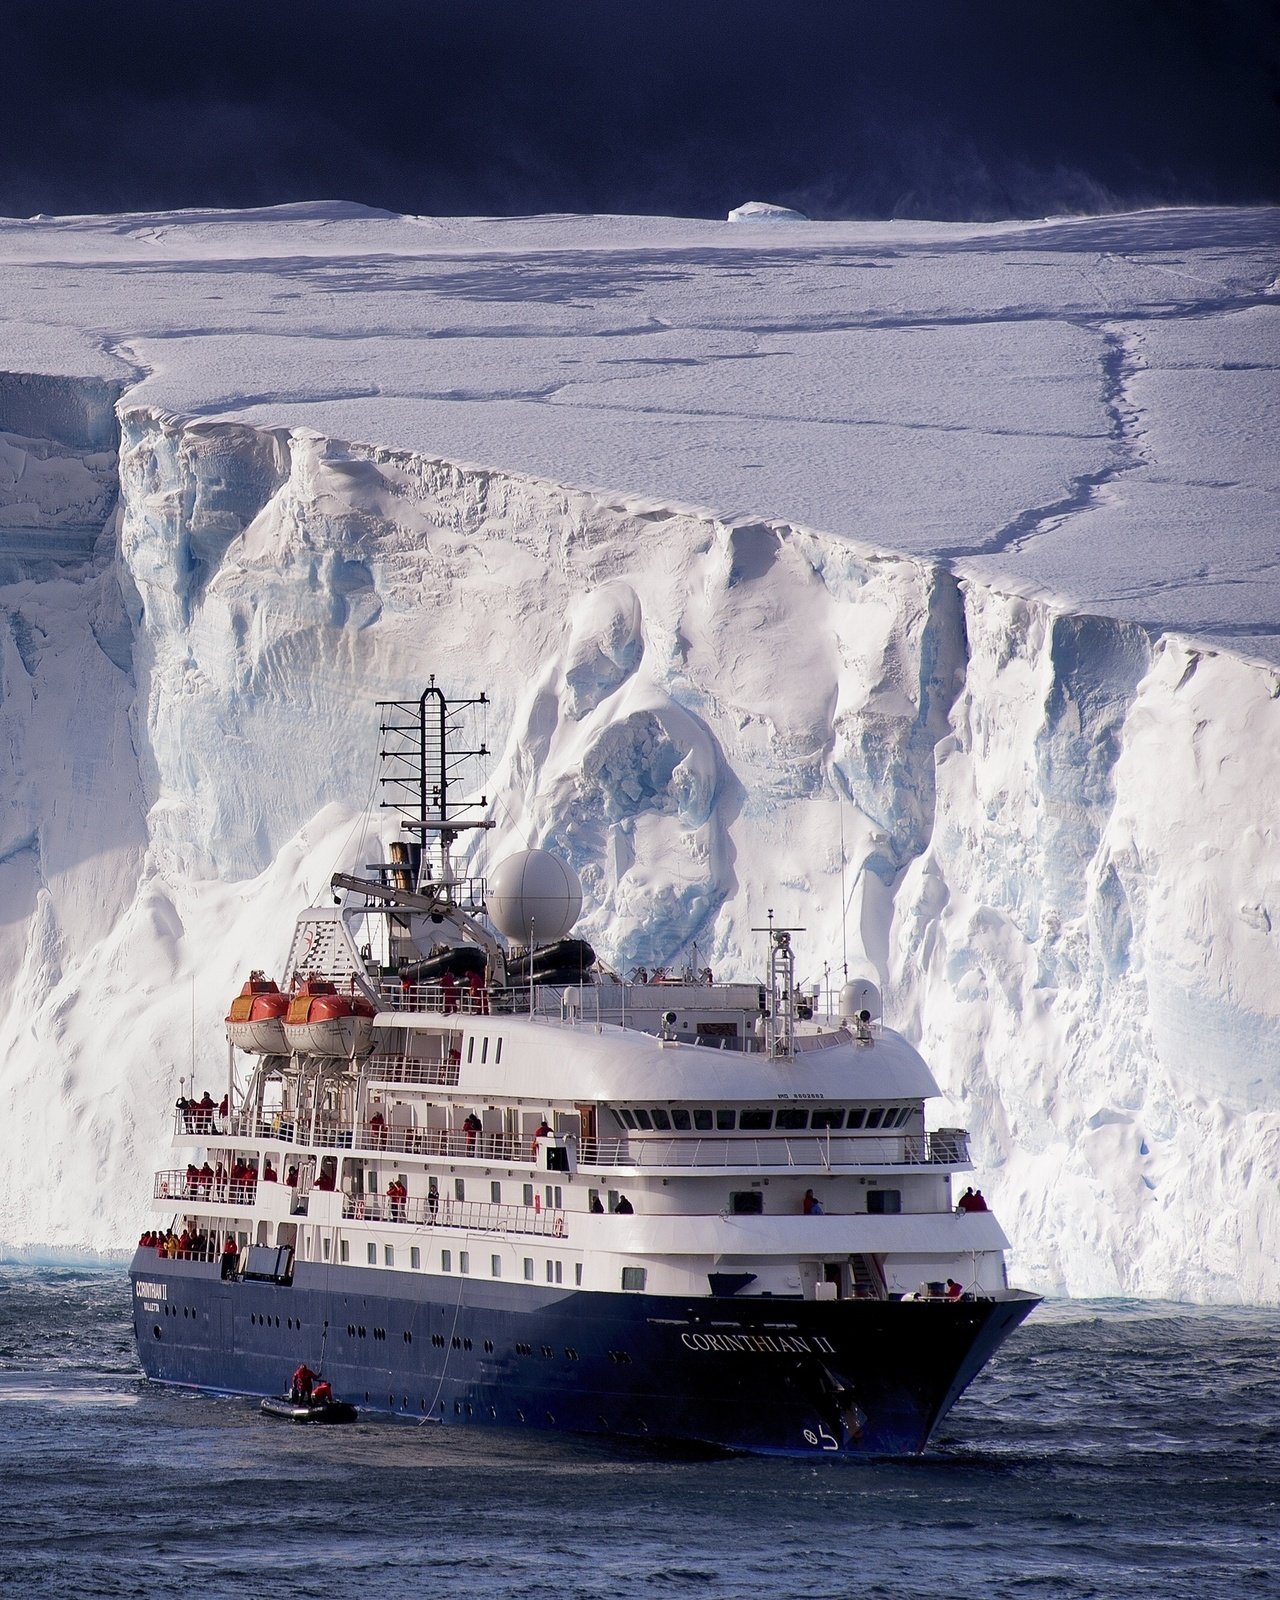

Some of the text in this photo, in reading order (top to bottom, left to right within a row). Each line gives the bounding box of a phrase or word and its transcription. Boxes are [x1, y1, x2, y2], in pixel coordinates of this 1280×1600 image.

[136, 1281, 168, 1301] CORINTHIAN II
[681, 1333, 837, 1353] CORINTHIAN II
